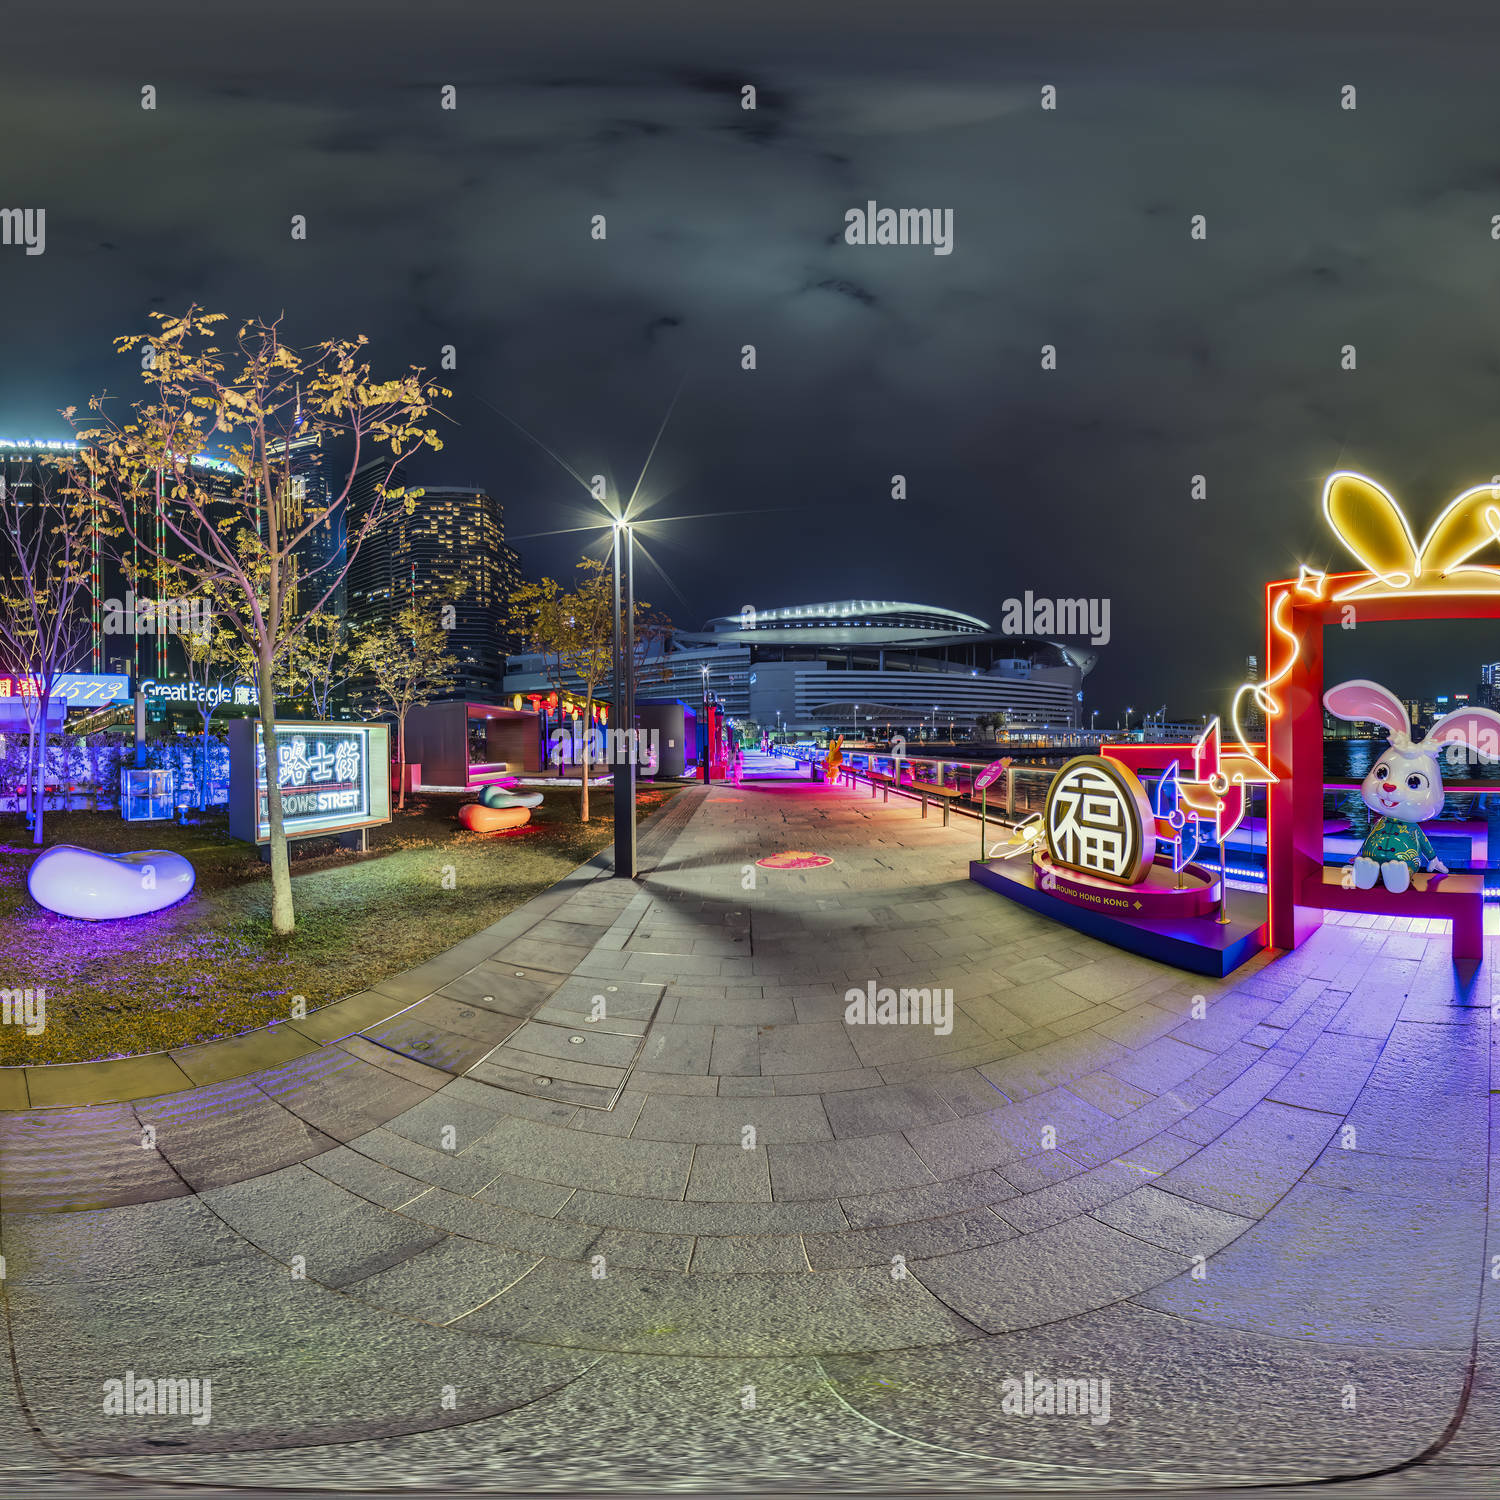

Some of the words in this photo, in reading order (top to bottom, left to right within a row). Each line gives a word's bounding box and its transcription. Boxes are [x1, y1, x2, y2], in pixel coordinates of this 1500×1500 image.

[50, 681, 124, 701] 1573
[140, 680, 188, 702] Great
[189, 682, 232, 707] Eagle
[317, 789, 360, 811] STREET
[1050, 767, 1132, 877] 福
[1079, 891, 1102, 904] HONG
[1103, 897, 1129, 908] KONG
